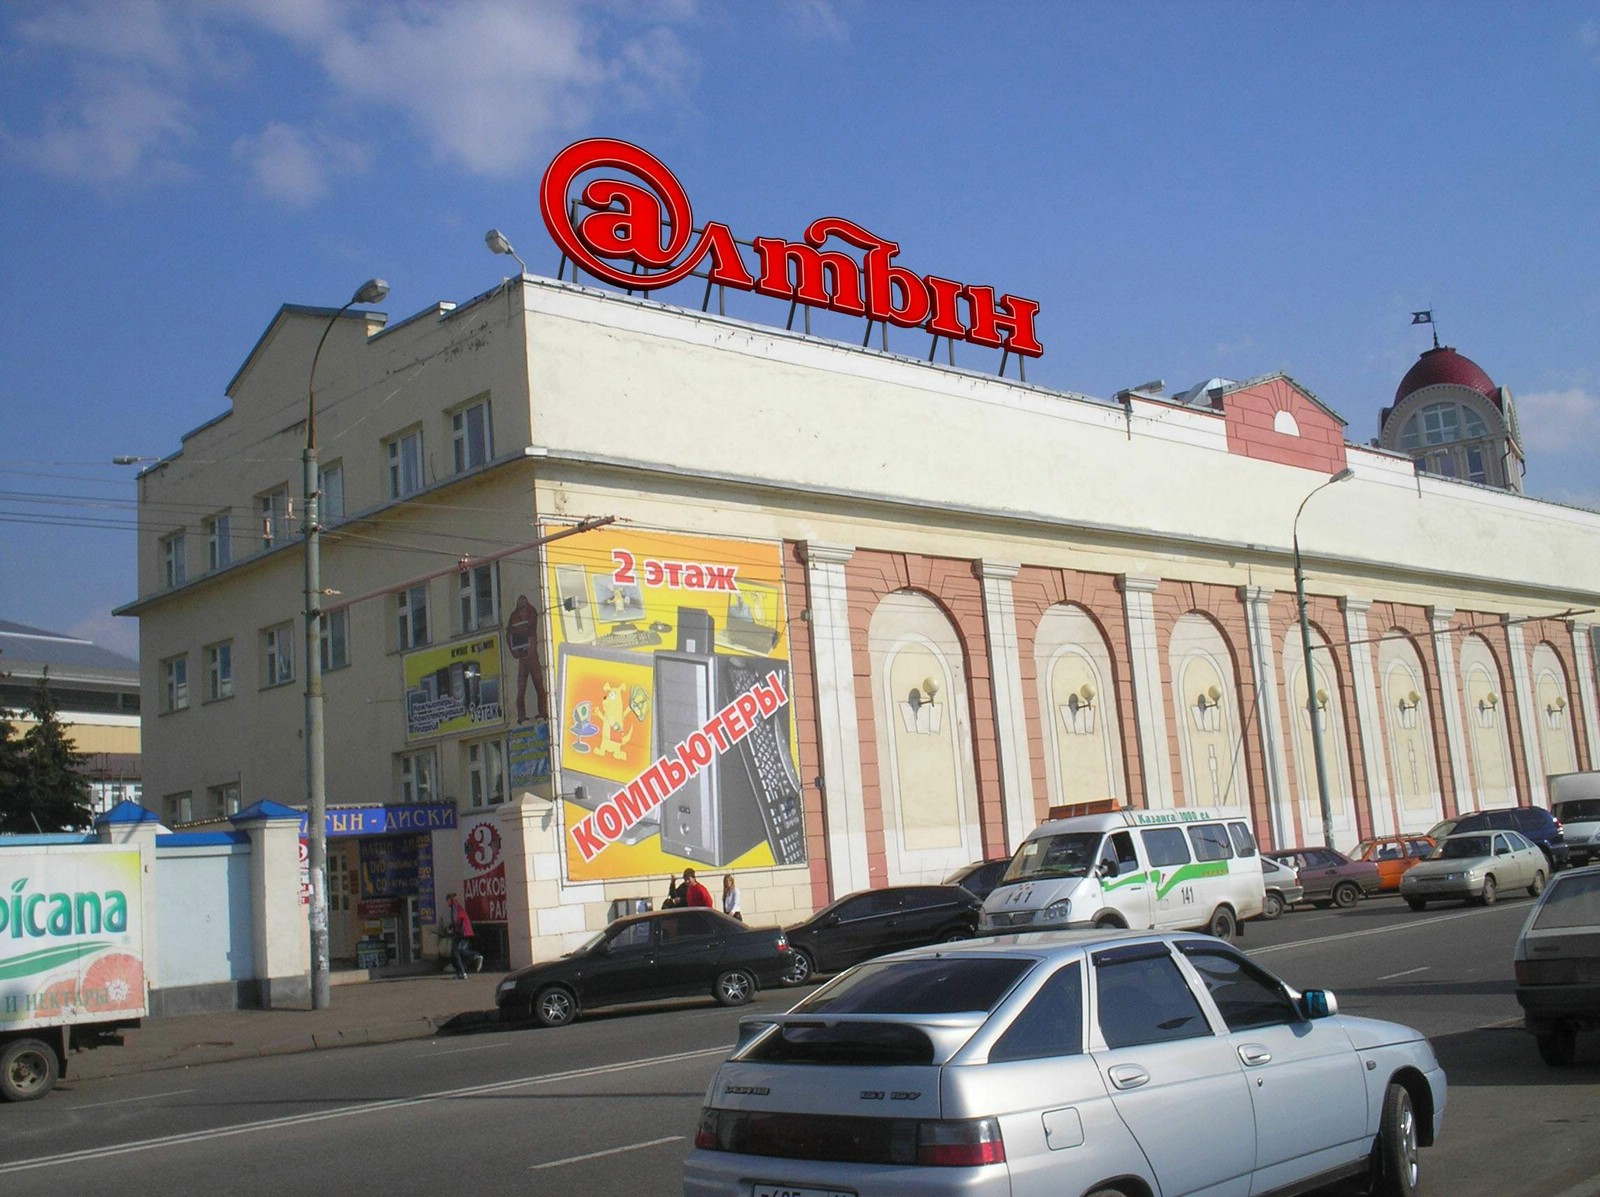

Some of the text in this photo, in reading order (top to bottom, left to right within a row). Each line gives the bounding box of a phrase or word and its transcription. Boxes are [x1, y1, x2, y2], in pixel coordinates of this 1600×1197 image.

[613, 550, 739, 591] 2 этаж
[573, 673, 788, 860] КОМПЬЮТЕРЫ
[384, 808, 454, 832] ДИСКИ
[1137, 813, 1176, 825] Казанга
[1179, 811, 1197, 821] 1000
[1005, 891, 1033, 905] 141
[1181, 886, 1195, 904] 141
[5, 988, 109, 1013] И НЕКТАРЫ
